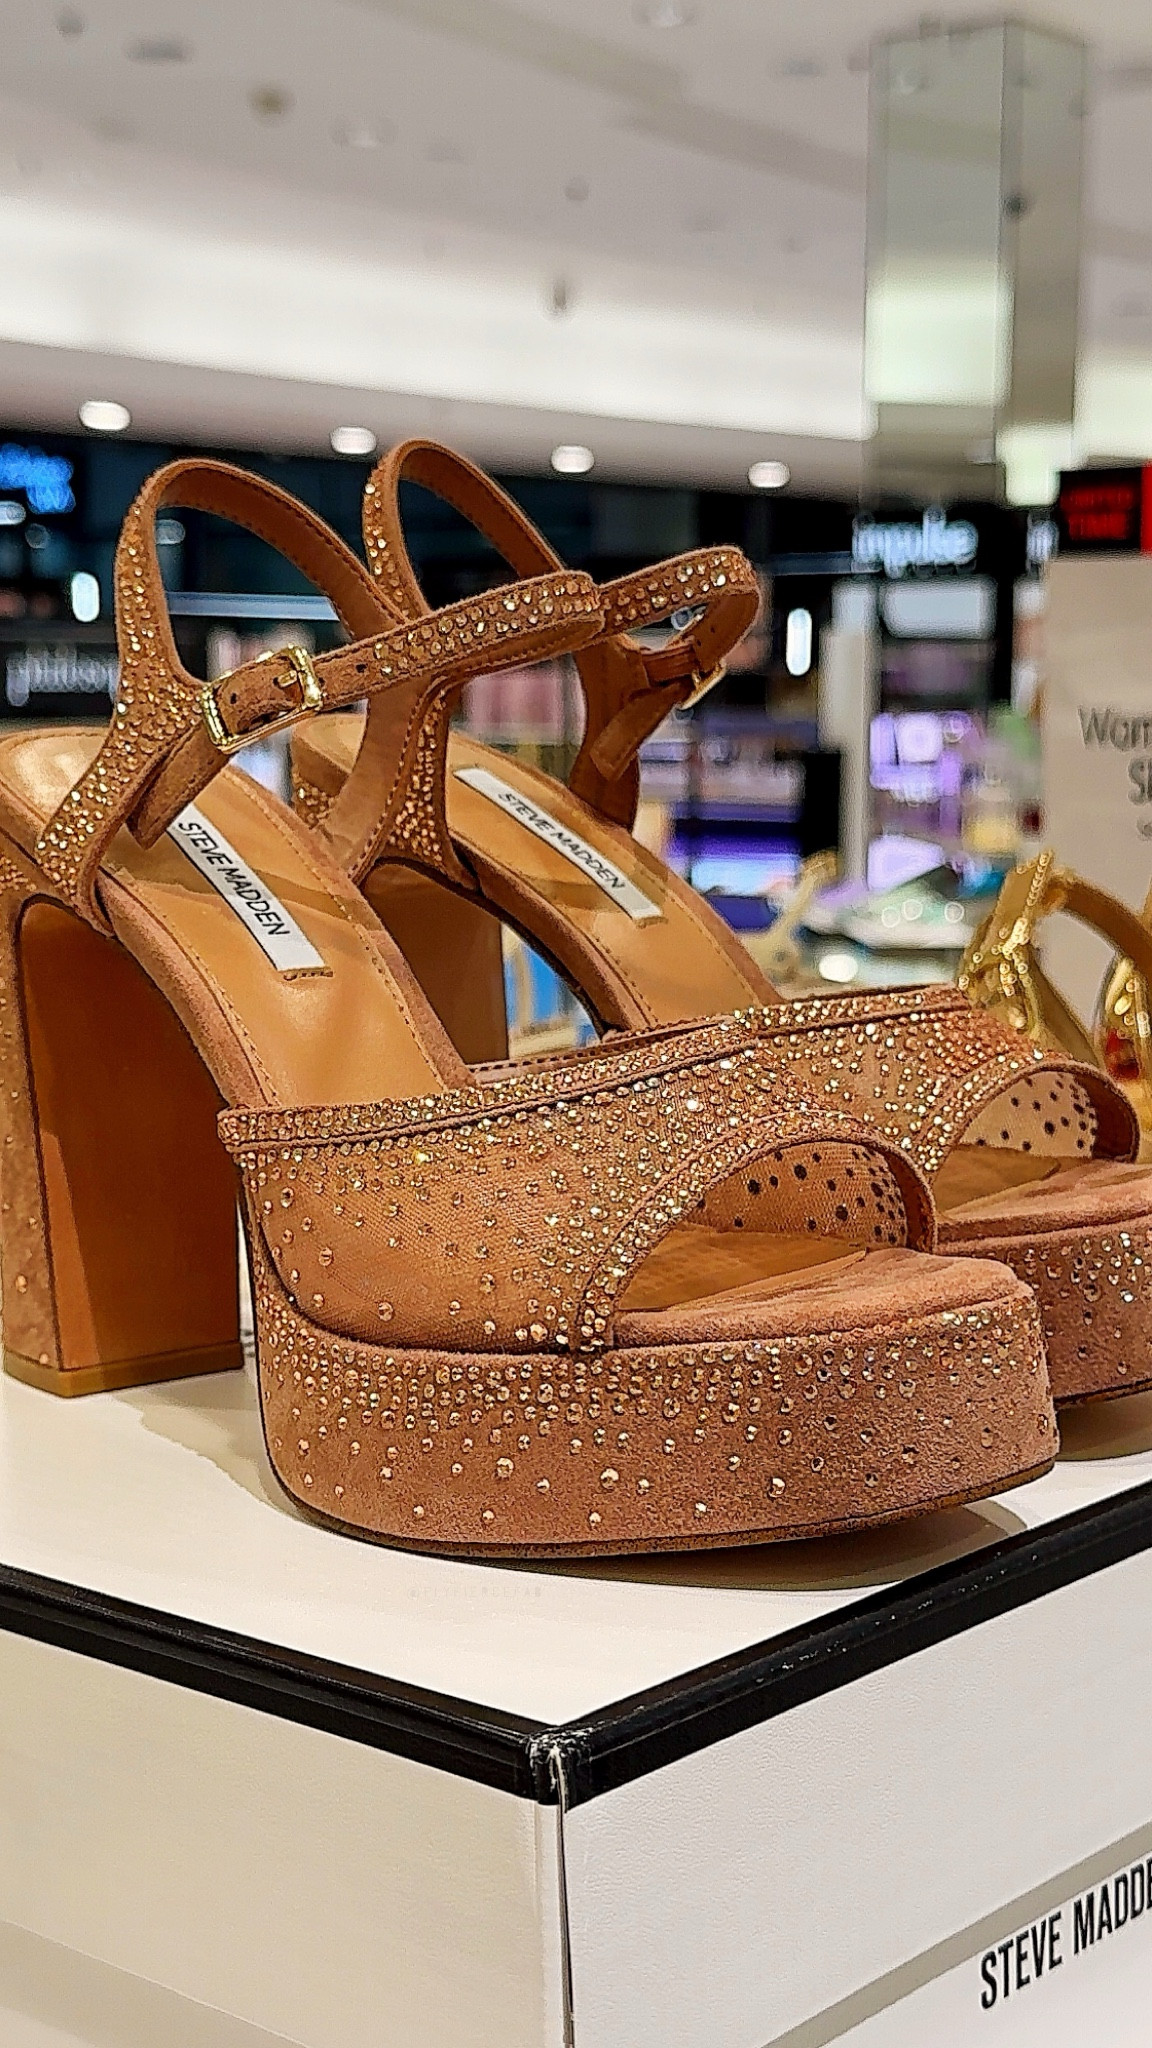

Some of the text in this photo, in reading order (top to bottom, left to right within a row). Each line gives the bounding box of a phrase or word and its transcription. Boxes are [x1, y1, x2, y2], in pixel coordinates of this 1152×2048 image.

[178, 822, 290, 935] STEVE MADDEN
[498, 793, 625, 889] STEVE MADDEN
[981, 1911, 1063, 2010] STEVE
